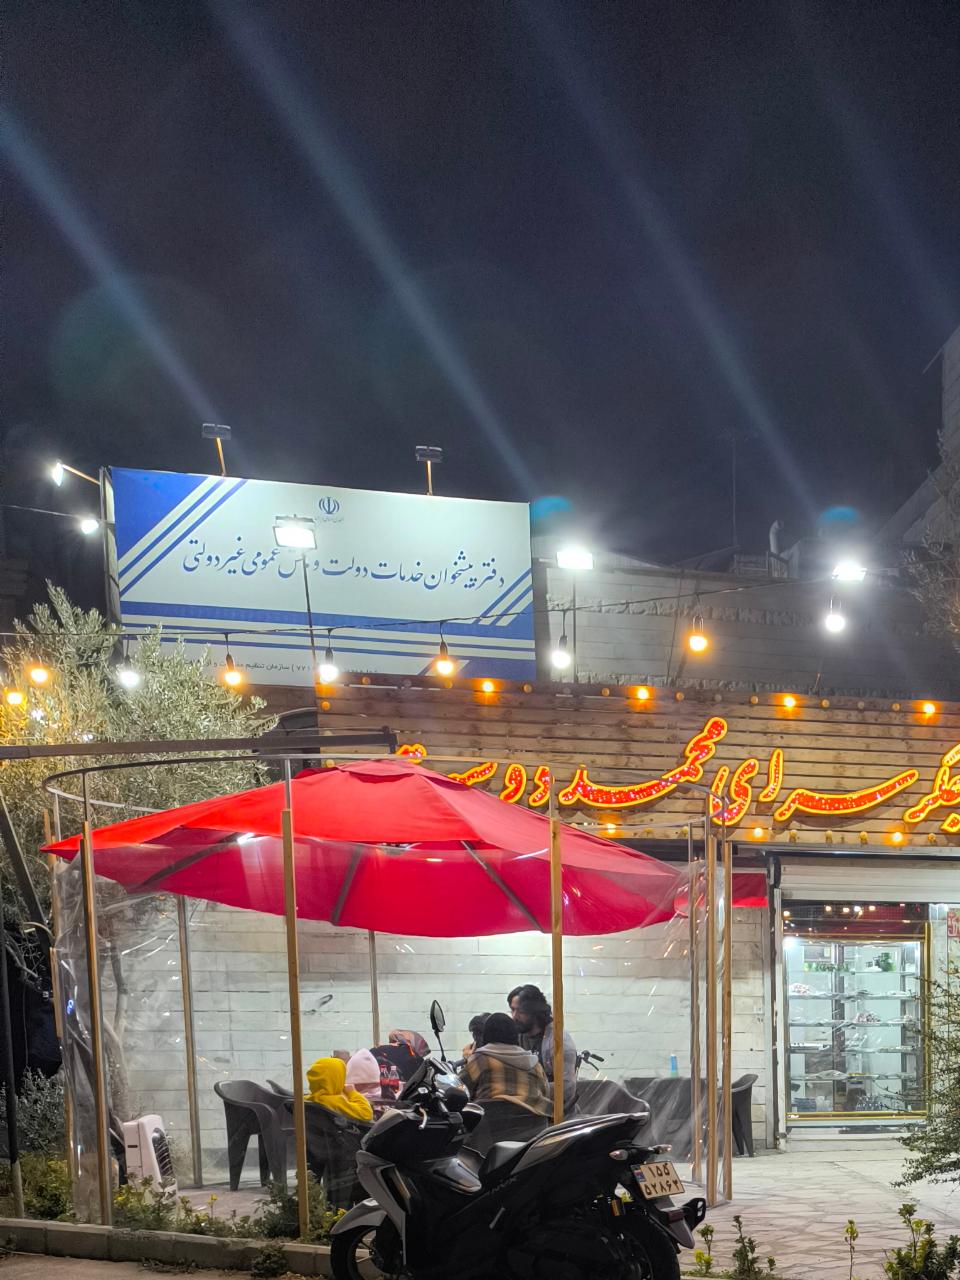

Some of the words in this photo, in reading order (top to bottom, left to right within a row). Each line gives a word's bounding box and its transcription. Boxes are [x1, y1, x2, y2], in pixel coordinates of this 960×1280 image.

[183, 538, 220, 573] دولتی
[217, 535, 246, 575] غیر
[241, 547, 280, 576] عمومی
[312, 559, 320, 571] و
[322, 555, 368, 578] دولت
[423, 550, 478, 590] پیشخوان
[370, 561, 424, 583] خدمات
[475, 557, 505, 591] دفتر
[709, 748, 920, 826] سرای
[648, 1162, 670, 1178] ۱۵۵
